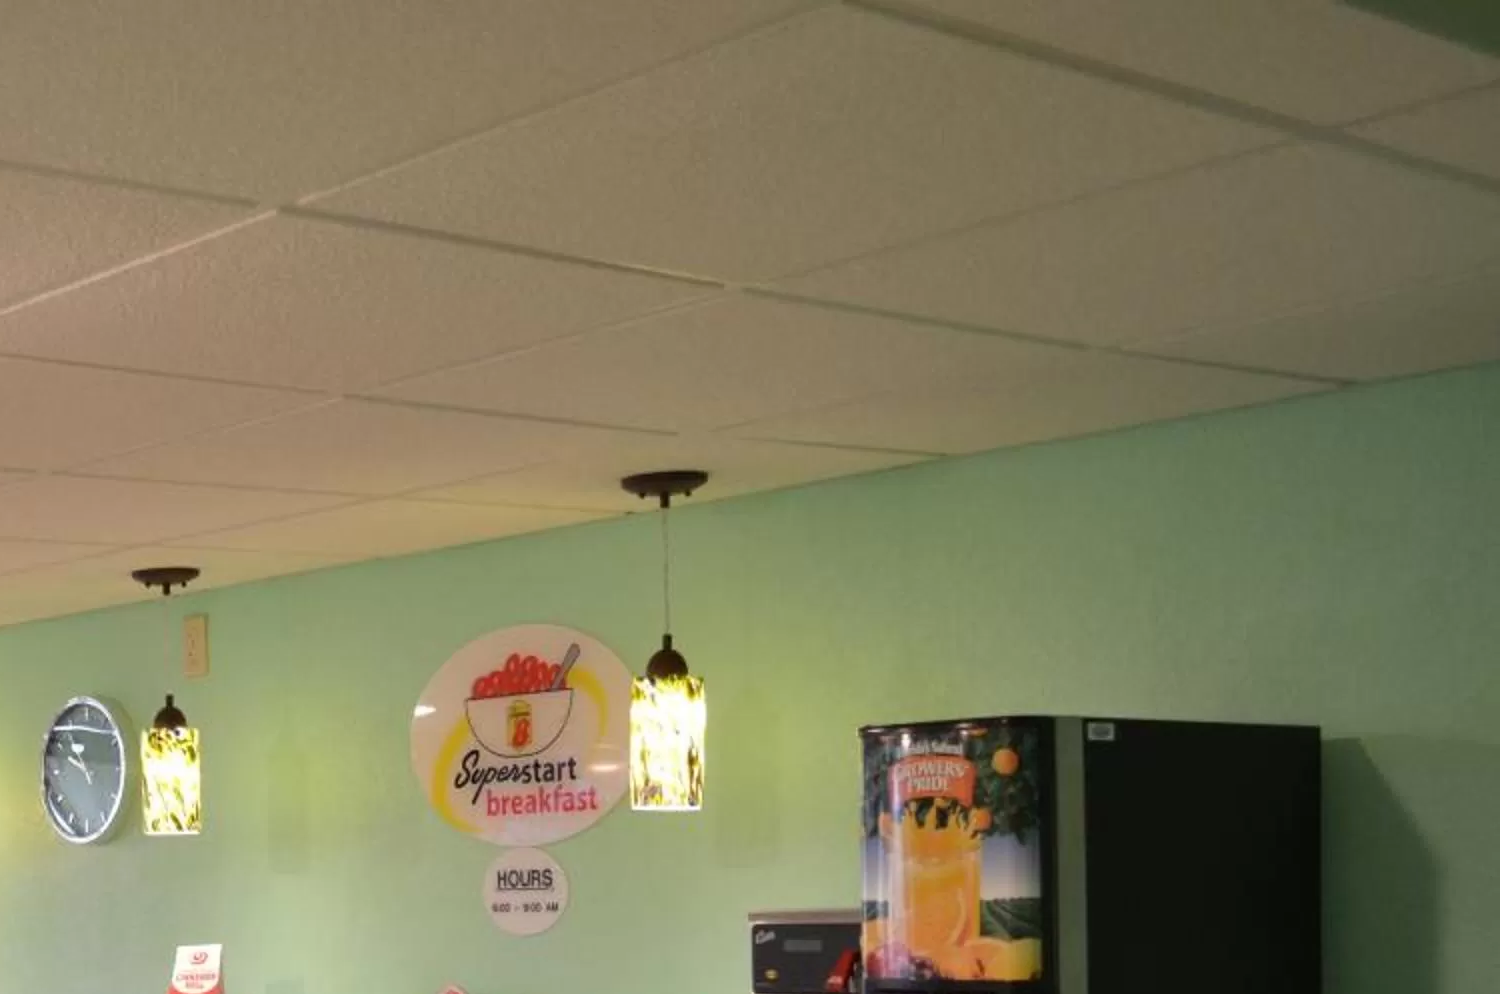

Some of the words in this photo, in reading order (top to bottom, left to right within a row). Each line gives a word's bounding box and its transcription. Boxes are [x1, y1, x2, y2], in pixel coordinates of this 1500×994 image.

[454, 750, 577, 804] Superstart
[487, 784, 598, 816] breakfast
[497, 868, 554, 889] HOURS
[545, 900, 560, 912] AM
